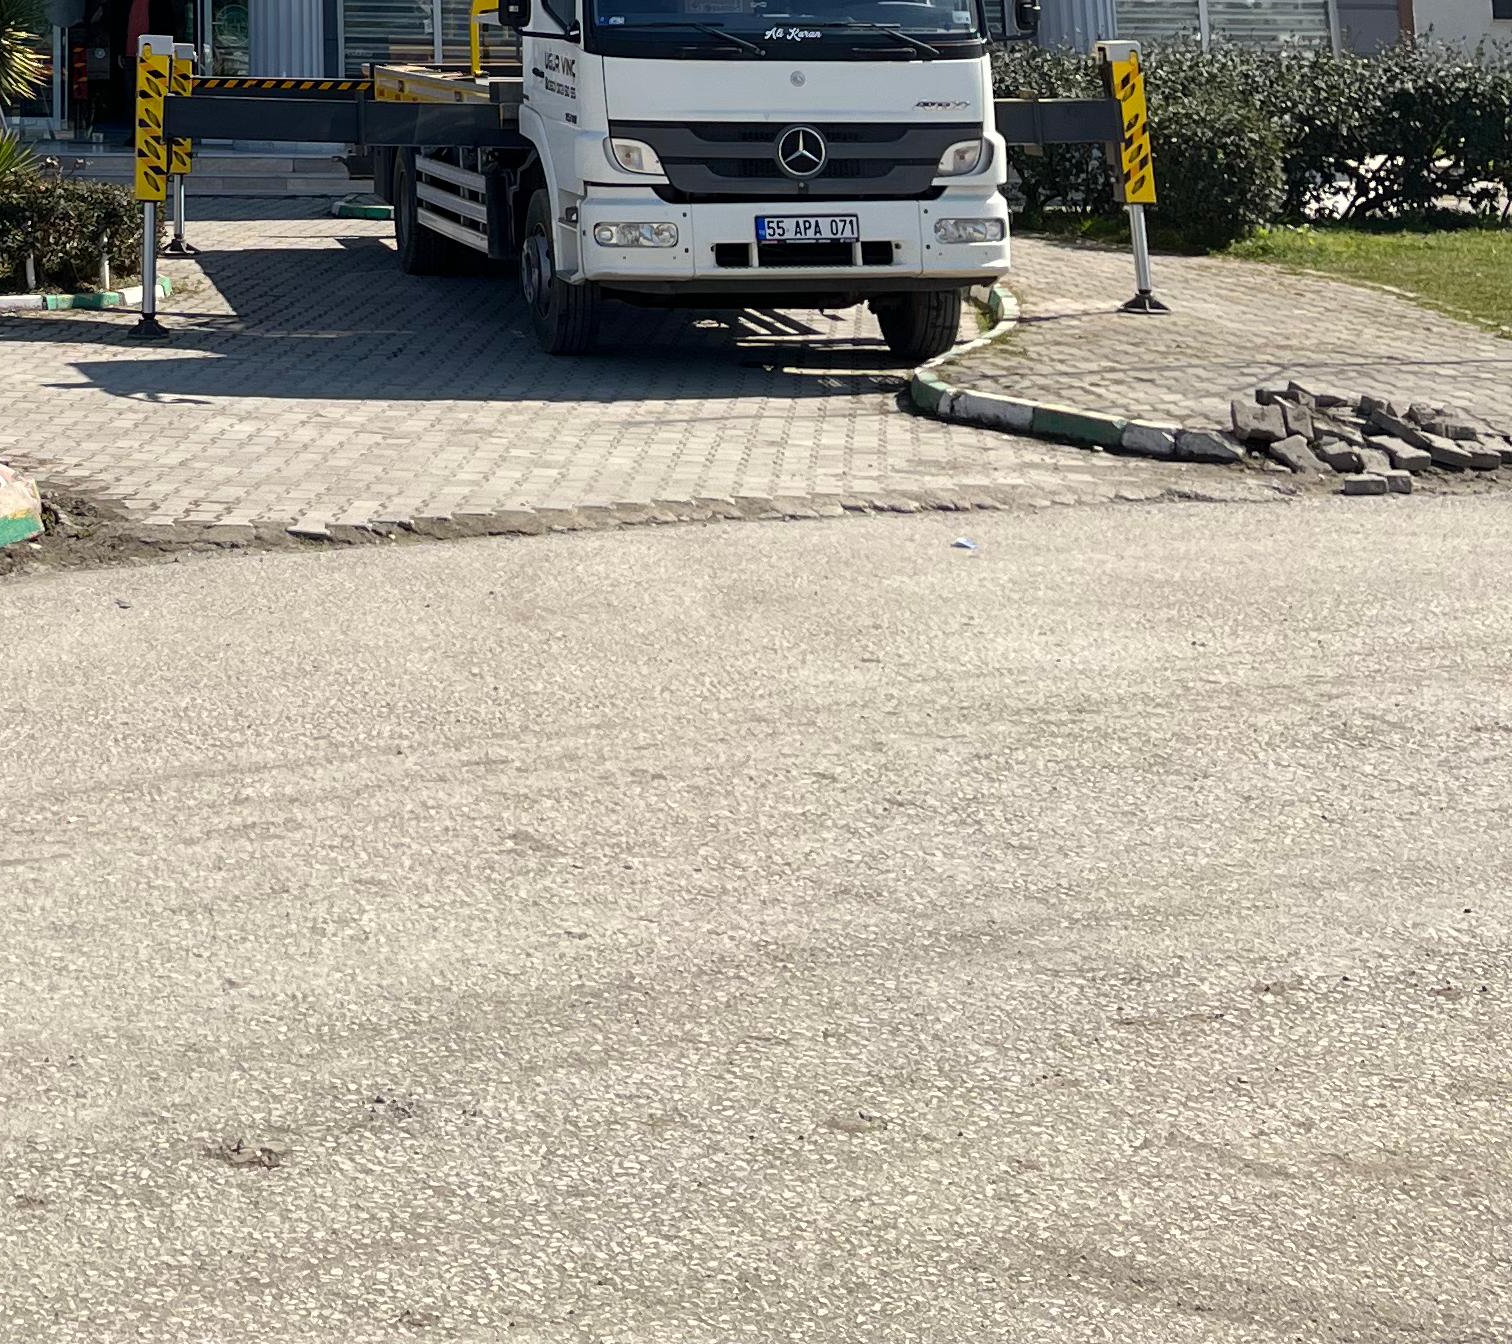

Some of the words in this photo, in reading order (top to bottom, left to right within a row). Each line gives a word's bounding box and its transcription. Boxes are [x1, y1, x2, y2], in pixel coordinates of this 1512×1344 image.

[766, 219, 786, 237] 55
[794, 219, 823, 237] APA
[830, 218, 855, 236] 071
